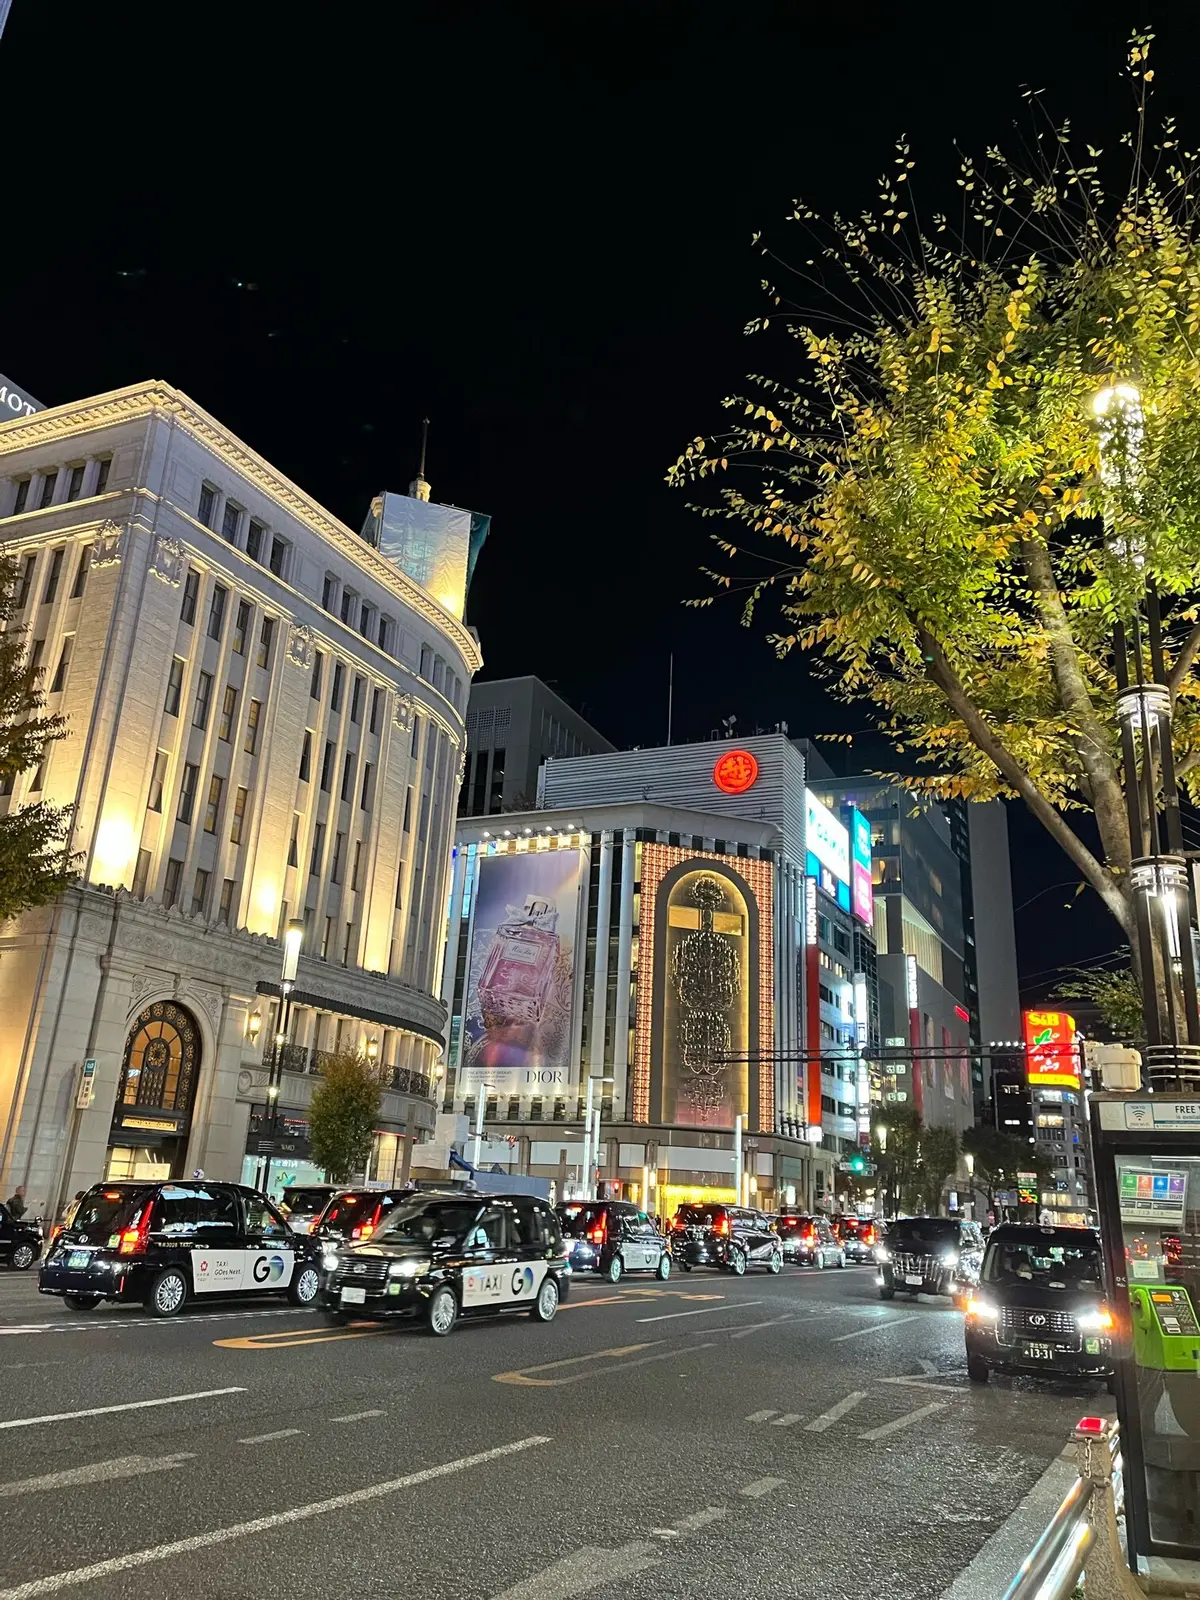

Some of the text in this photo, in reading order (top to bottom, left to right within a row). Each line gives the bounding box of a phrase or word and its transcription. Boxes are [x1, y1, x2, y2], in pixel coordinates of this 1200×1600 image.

[1028, 1012, 1060, 1026] S&B
[526, 1070, 562, 1084] DIOR
[1174, 1105, 1196, 1114] FREE
[253, 1255, 285, 1283] GO
[480, 1274, 503, 1293] TAXI
[511, 1267, 534, 1295] GO
[1030, 1348, 1053, 1360] 13-31
